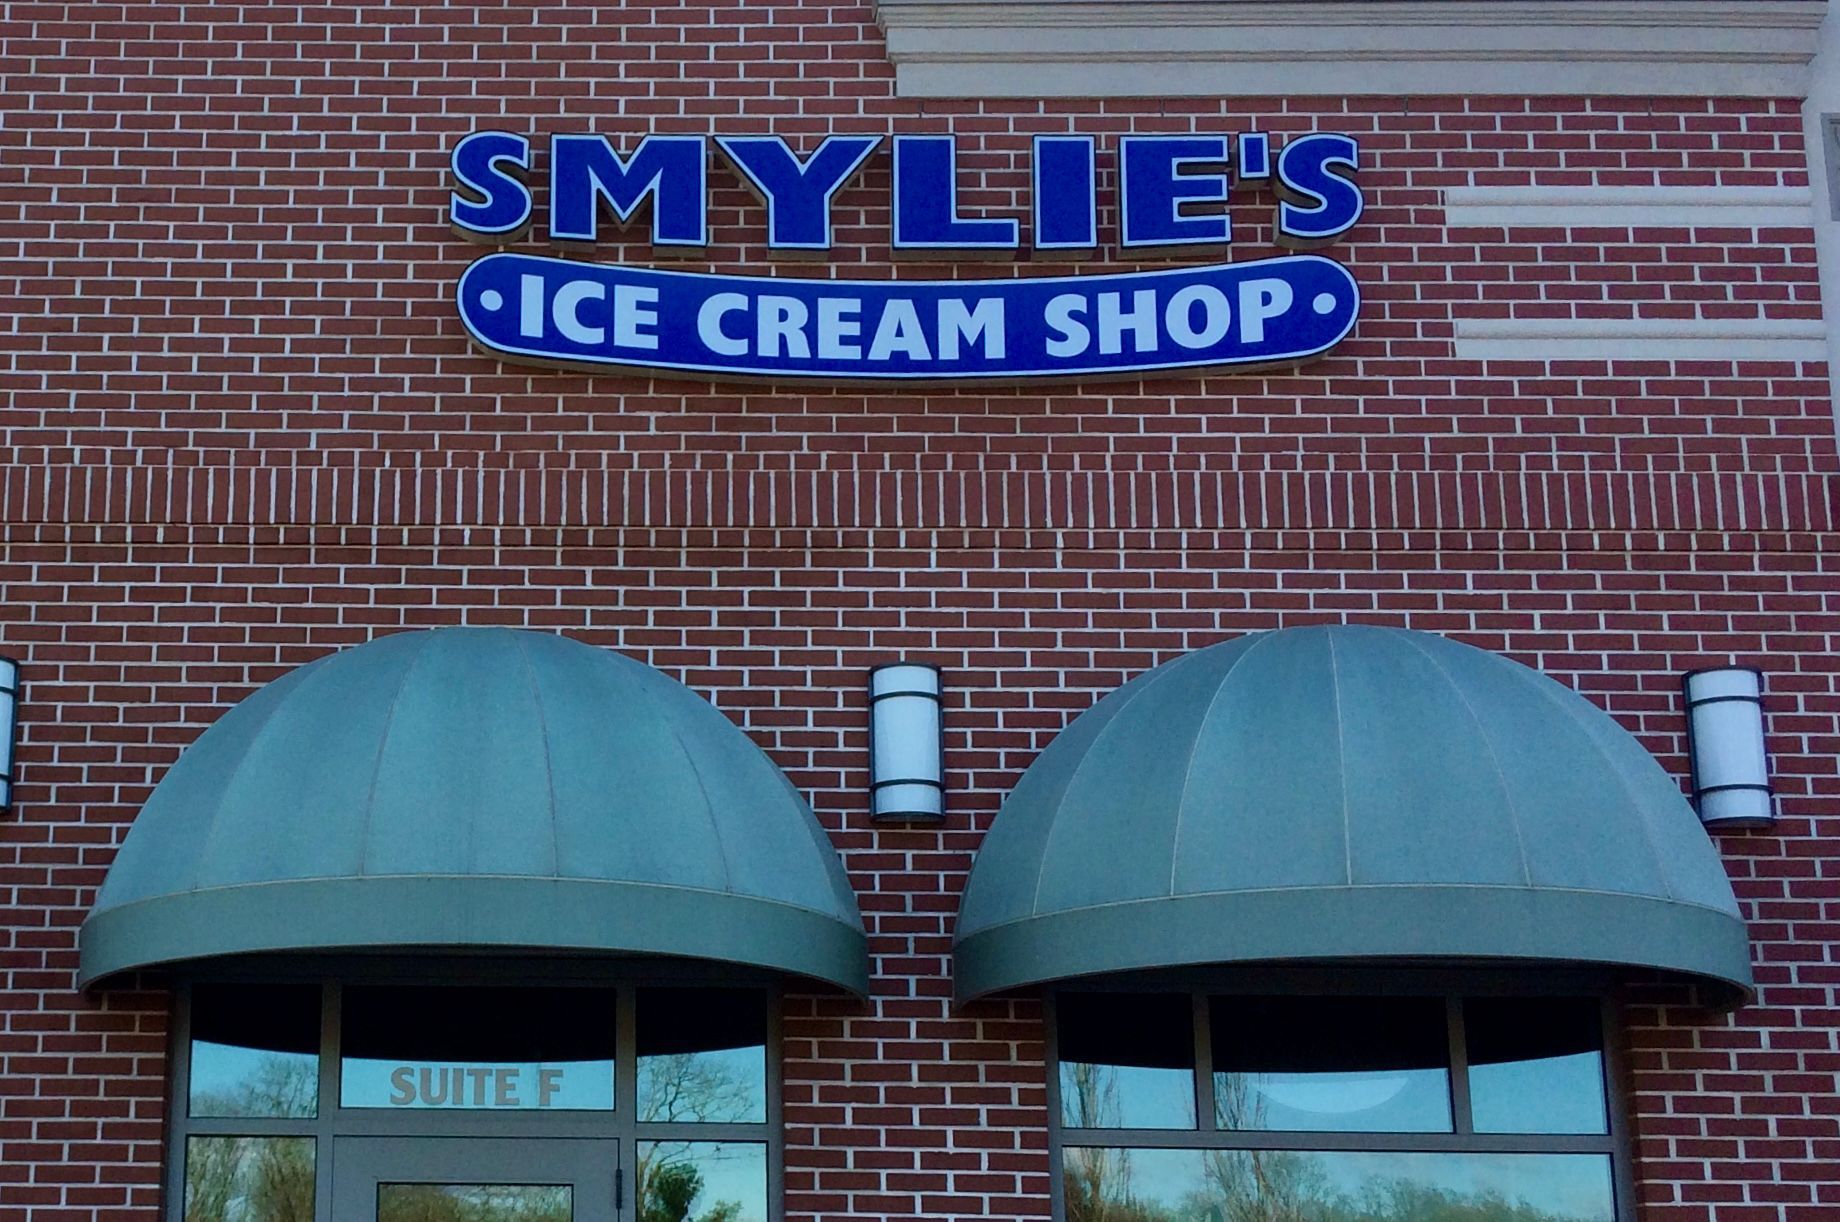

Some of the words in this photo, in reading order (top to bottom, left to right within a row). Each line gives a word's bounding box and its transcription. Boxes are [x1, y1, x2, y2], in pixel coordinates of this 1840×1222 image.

[450, 130, 1364, 249] SMYLIE'S
[520, 273, 659, 349] ICE
[697, 291, 1006, 361] CREAM
[1044, 277, 1294, 358] SHOP
[390, 1066, 520, 1106] SUITE
[539, 1068, 564, 1107] F
